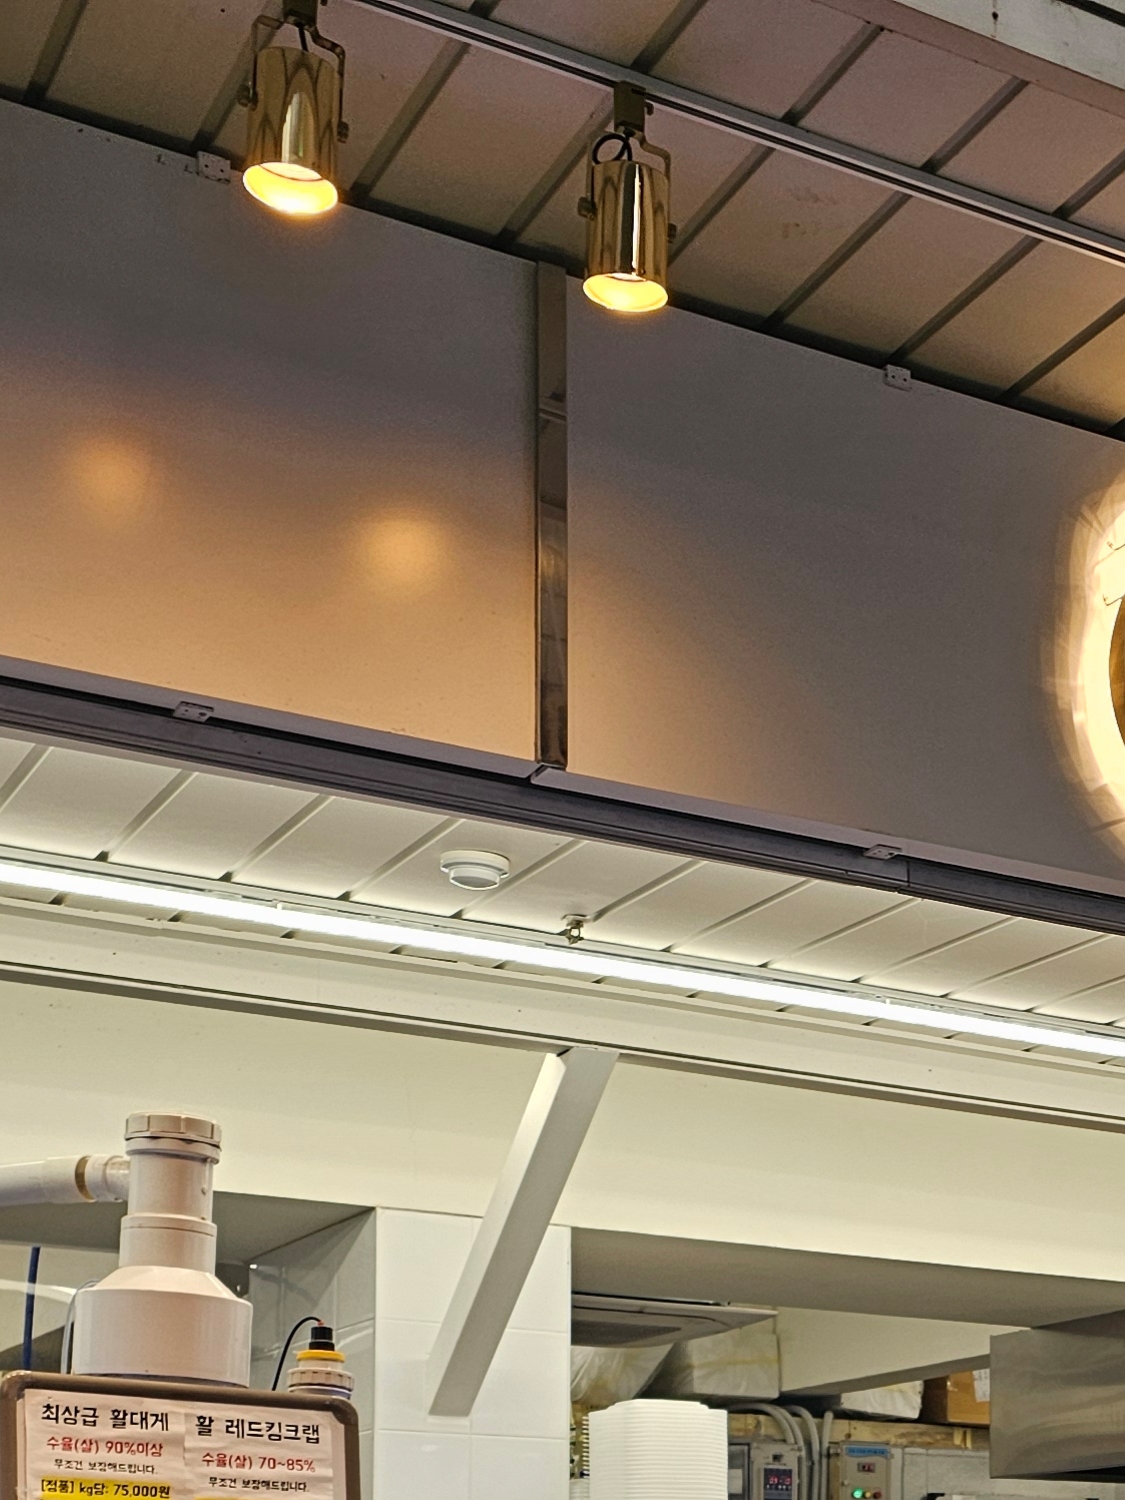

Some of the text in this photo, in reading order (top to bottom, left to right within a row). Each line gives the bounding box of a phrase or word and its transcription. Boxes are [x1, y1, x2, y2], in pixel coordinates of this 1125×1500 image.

[41, 1403, 169, 1431] 최상급 활대게
[195, 1415, 320, 1444] 활 레드킹크랩
[46, 1436, 164, 1457] 수율(살) 90%이상
[54, 1458, 158, 1475] 무조건 보장해드립니다.
[202, 1452, 316, 1472] 수율(살) 70~85%
[41, 1479, 170, 1498] [정품] kg당: 75,000원
[208, 1476, 309, 1493] 무조건 보장해드립니다.
